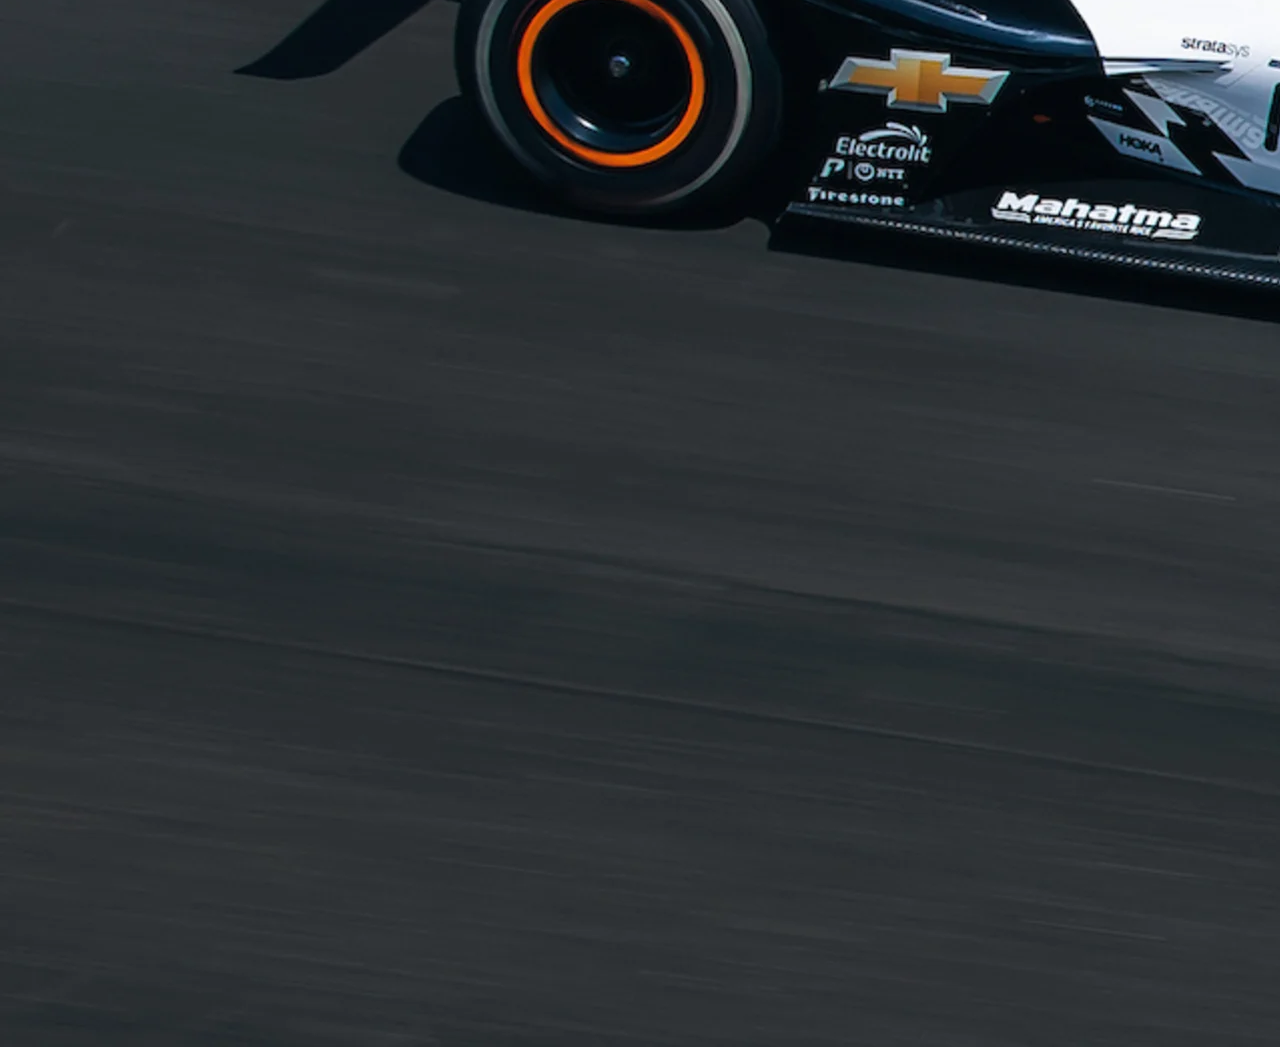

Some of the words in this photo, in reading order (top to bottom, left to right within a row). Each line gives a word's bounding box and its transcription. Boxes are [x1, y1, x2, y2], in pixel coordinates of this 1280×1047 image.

[1181, 36, 1251, 57] stratasys
[836, 136, 933, 163] Electrolit
[1119, 133, 1163, 158] HOKA
[876, 168, 905, 180] NTT
[807, 186, 905, 207] Firestone
[997, 191, 1201, 230] Mahatma
